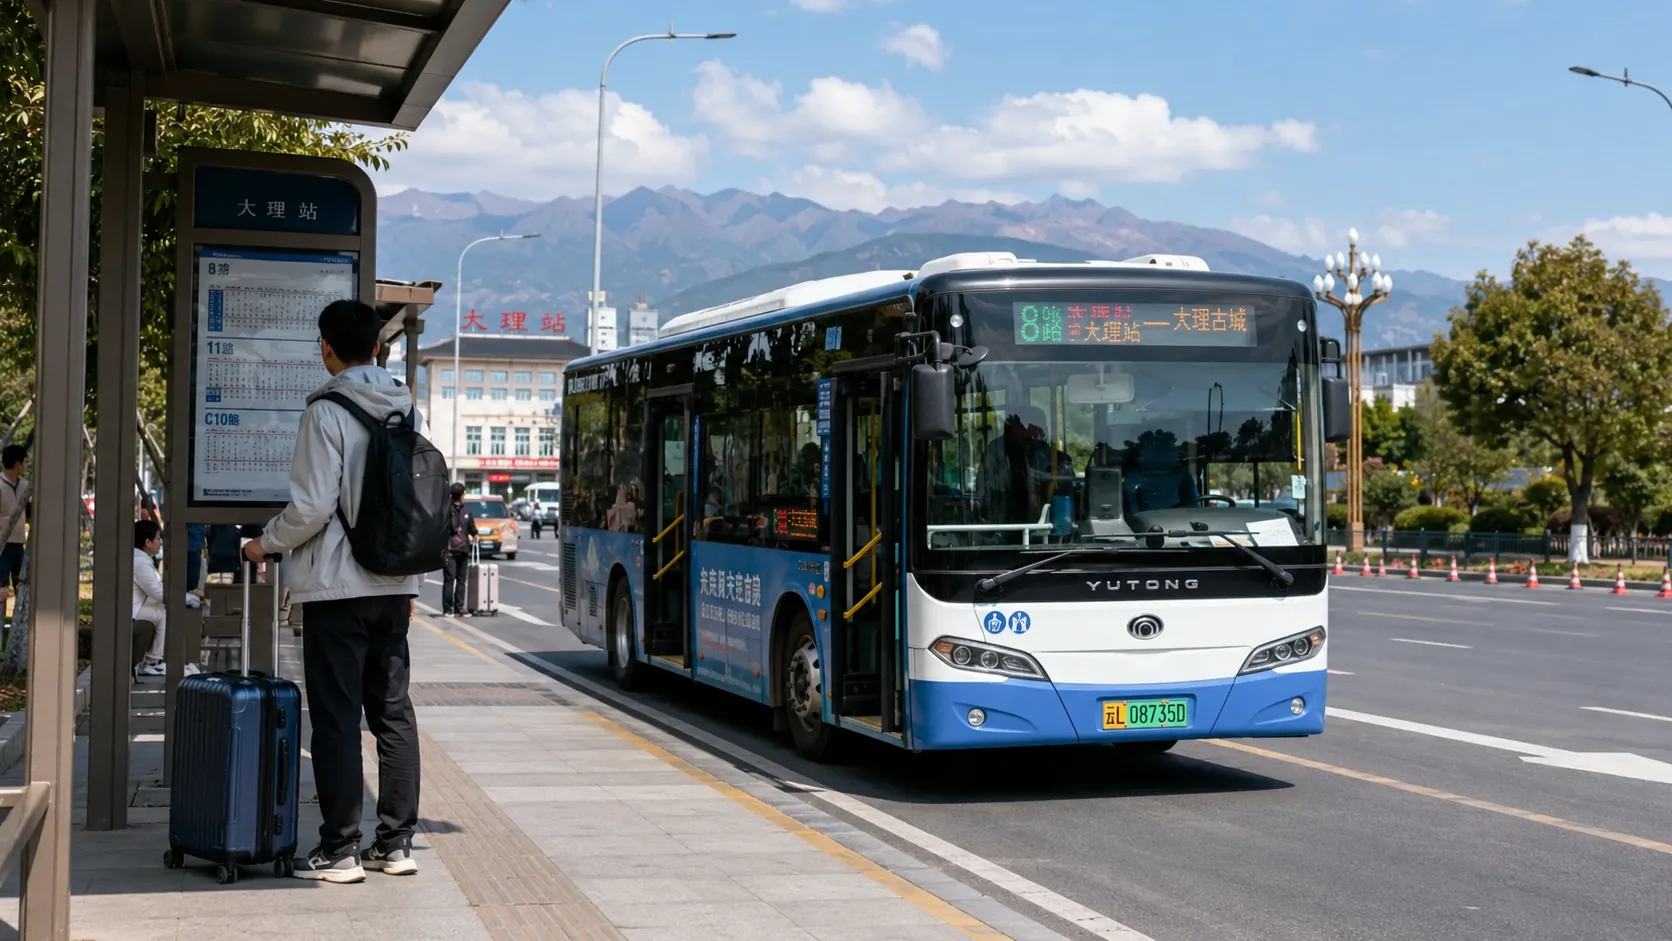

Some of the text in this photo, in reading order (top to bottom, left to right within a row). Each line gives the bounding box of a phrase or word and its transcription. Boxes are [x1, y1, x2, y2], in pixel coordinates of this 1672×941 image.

[238, 199, 317, 220] 大理站
[460, 309, 567, 333] 大理站
[1086, 579, 1199, 591] YUTONG
